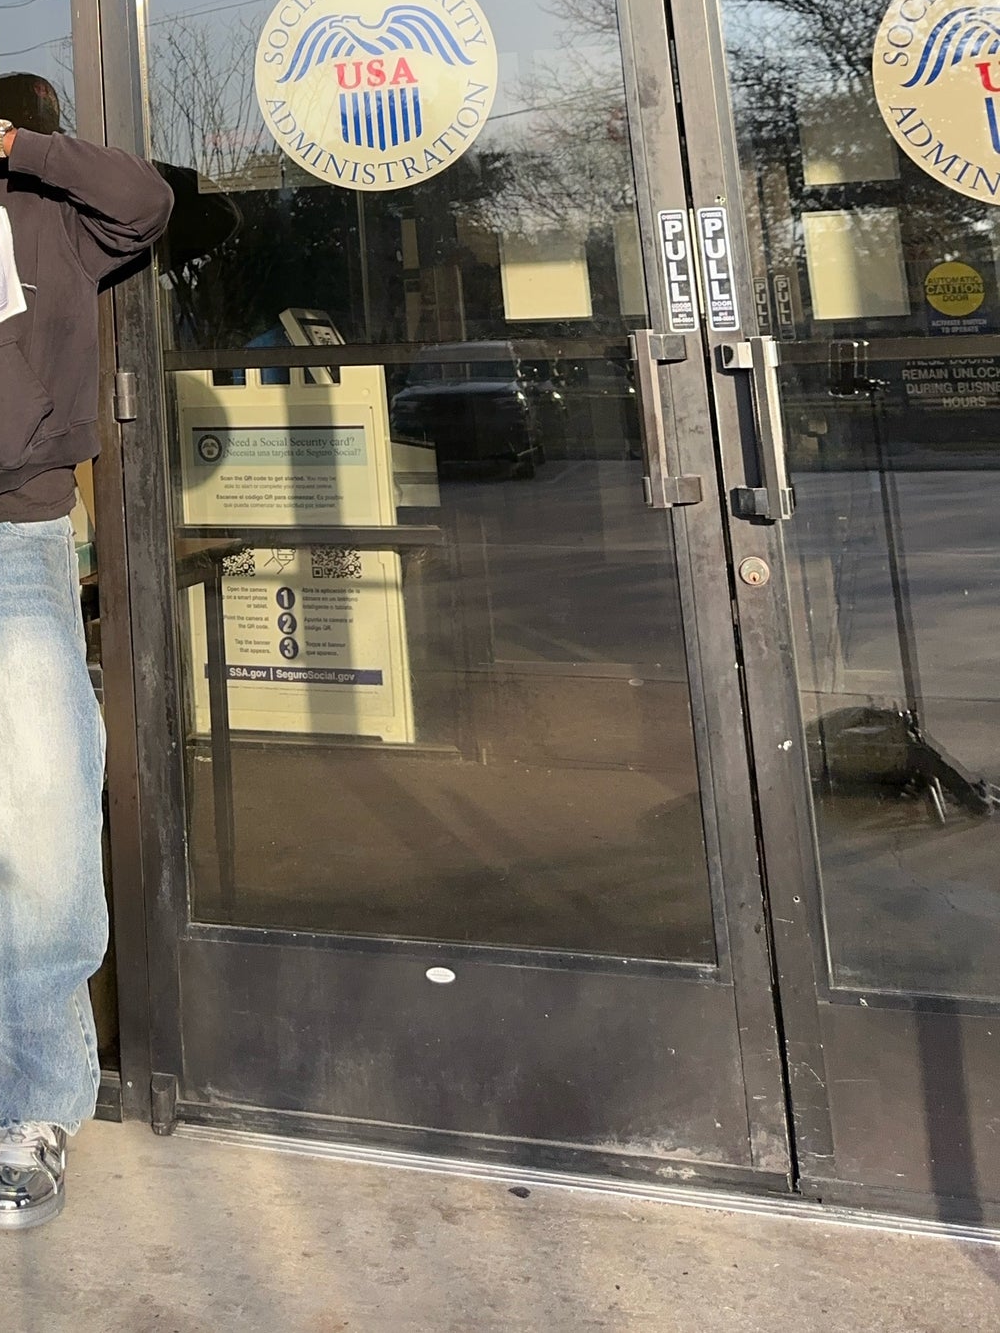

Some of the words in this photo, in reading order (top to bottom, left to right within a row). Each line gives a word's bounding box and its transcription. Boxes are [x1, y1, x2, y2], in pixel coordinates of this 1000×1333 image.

[334, 57, 418, 89] USA
[265, 80, 489, 186] ADMINISTRATION
[664, 220, 690, 302] PULL
[704, 218, 730, 300] PULL
[928, 275, 978, 284] AUTOMATIC
[925, 283, 984, 295] CAUTION
[755, 282, 769, 327] PULL
[777, 280, 791, 325] PULL
[942, 294, 969, 302] DOOR
[902, 369, 948, 380] REMAIN
[906, 382, 953, 395] DURING
[942, 396, 987, 408] HOURS
[227, 437, 249, 447] Need
[260, 437, 288, 447] Social
[290, 437, 327, 448] Security
[330, 437, 355, 447] card?
[281, 589, 289, 608] 1
[282, 614, 292, 633] 2
[283, 639, 294, 657] 3
[229, 667, 267, 679] SSA.gov
[276, 670, 355, 681] SeguroSocial.gov
